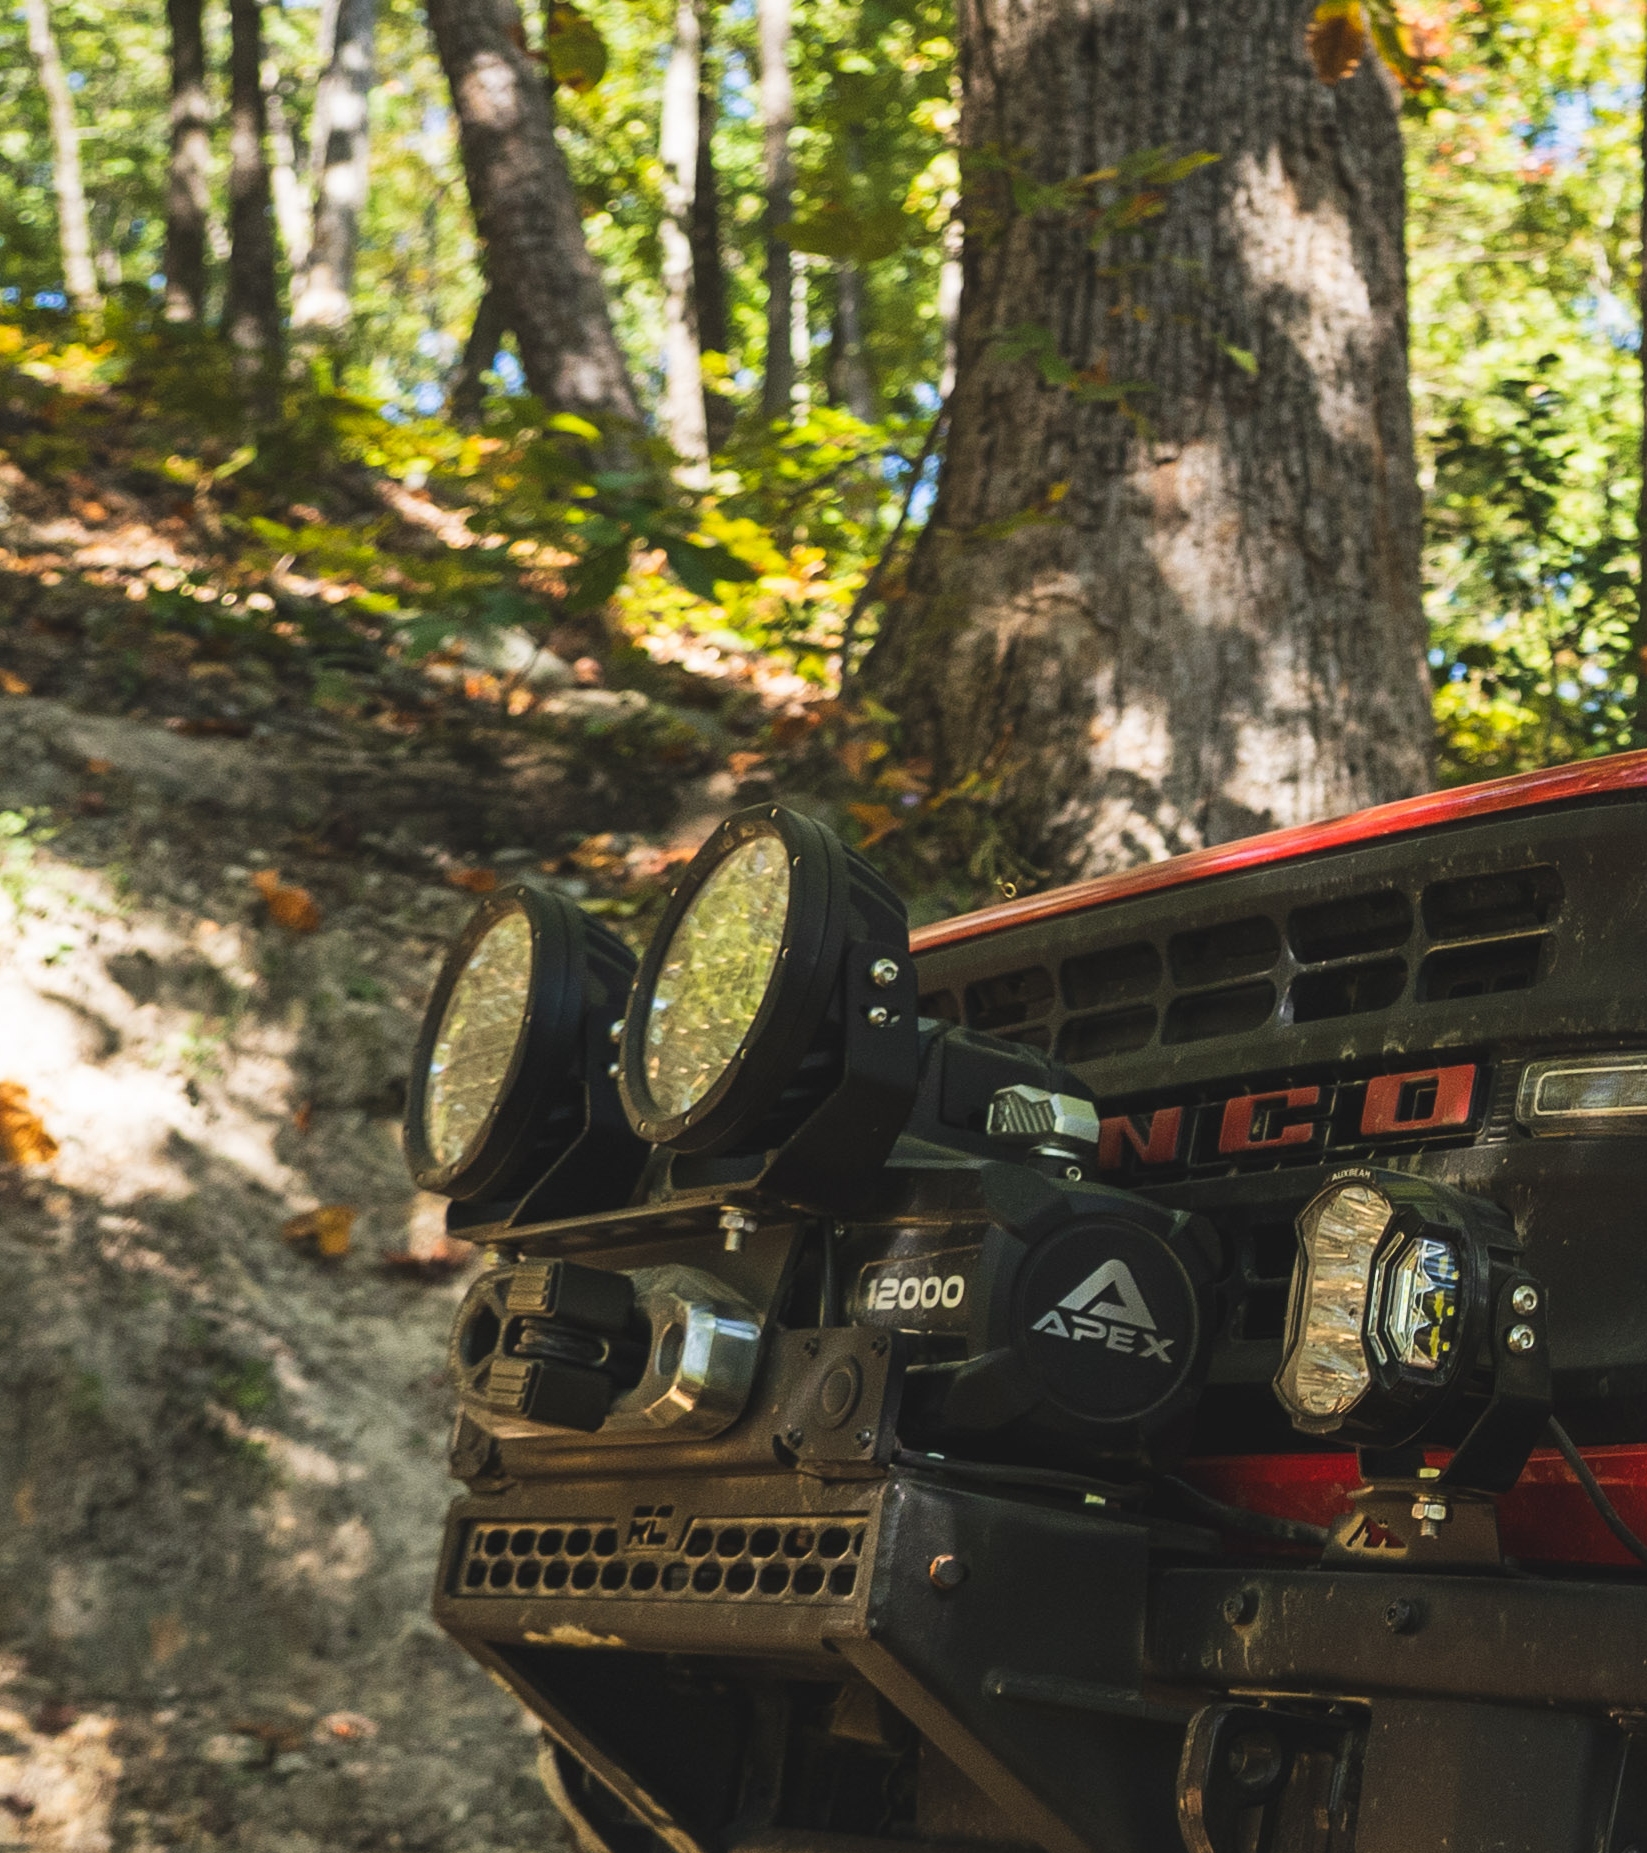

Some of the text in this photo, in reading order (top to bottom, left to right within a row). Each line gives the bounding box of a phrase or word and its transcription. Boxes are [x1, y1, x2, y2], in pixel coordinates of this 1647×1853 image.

[1098, 1064, 1477, 1169] NCO
[867, 1275, 965, 1311] 12000
[1031, 1310, 1175, 1364] APEX
